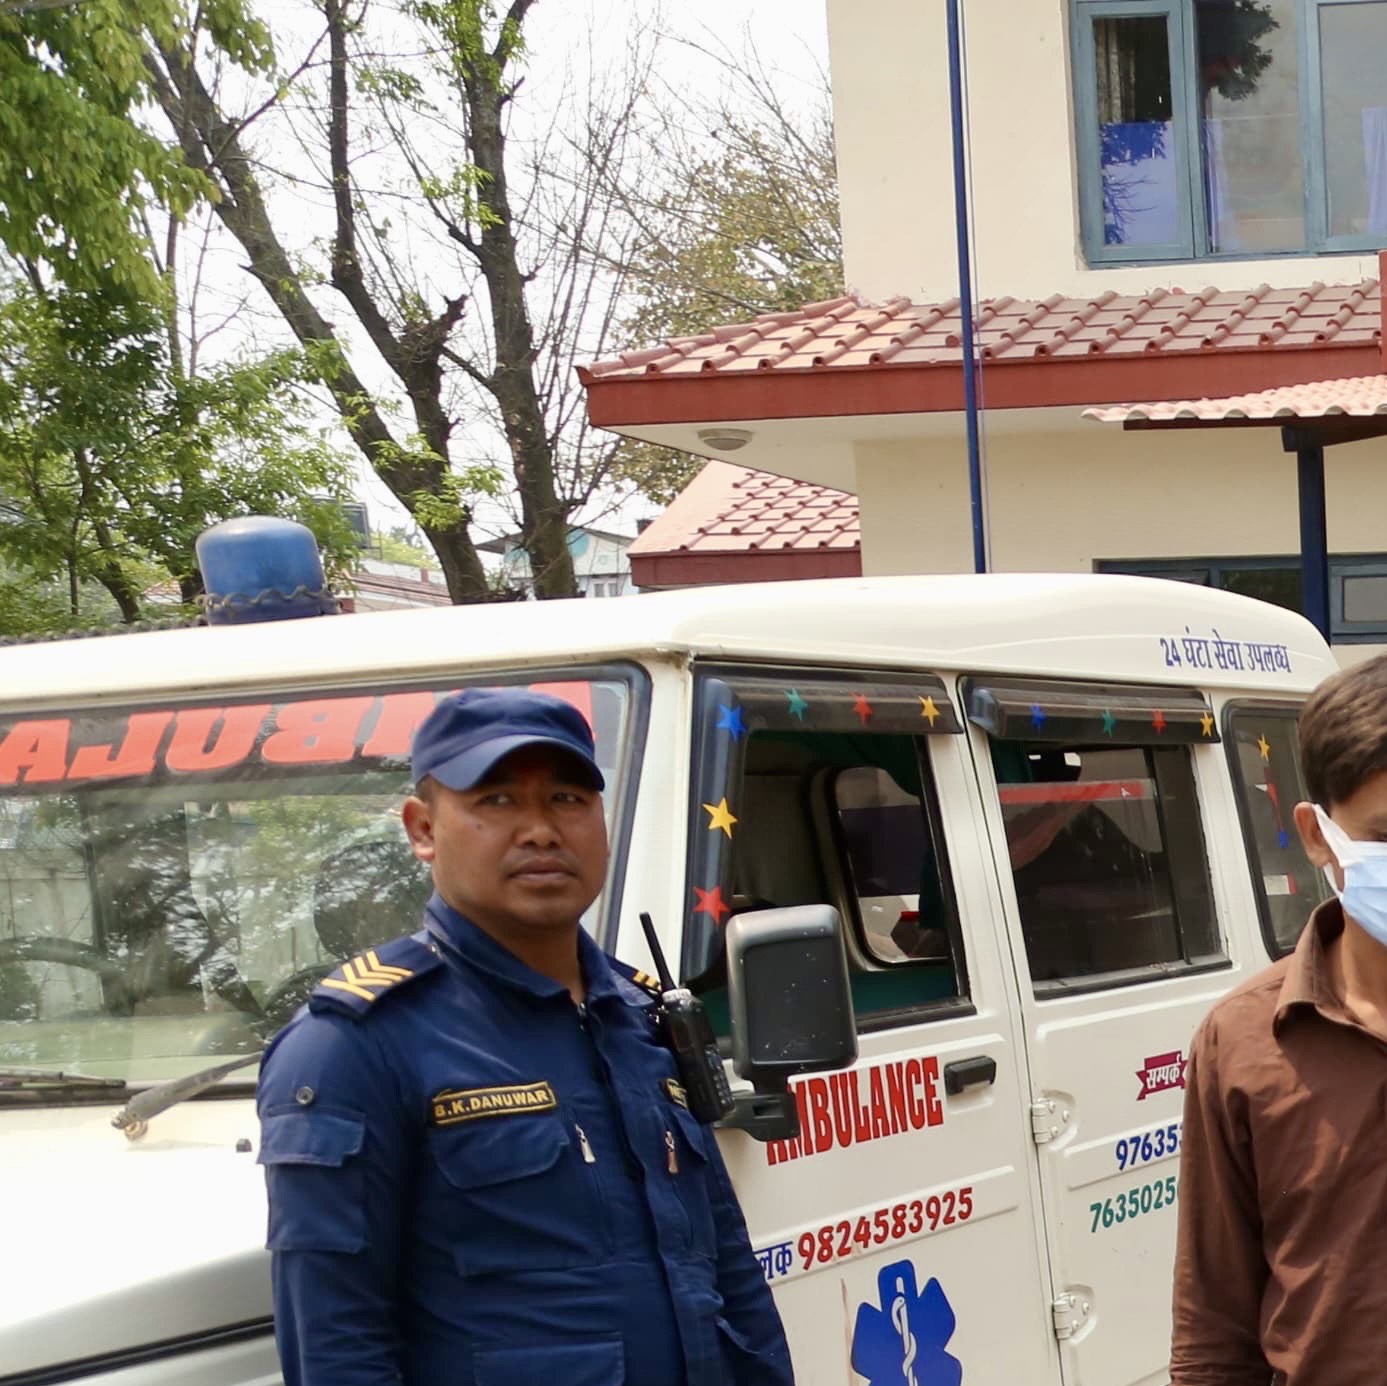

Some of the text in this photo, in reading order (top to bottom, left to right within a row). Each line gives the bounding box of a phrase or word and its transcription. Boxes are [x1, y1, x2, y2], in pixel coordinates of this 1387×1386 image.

[1160, 638, 1182, 668] 24
[1212, 629, 1245, 671] सेवा
[1116, 1124, 1183, 1171] 97635
[798, 1187, 973, 1271] 9824583925
